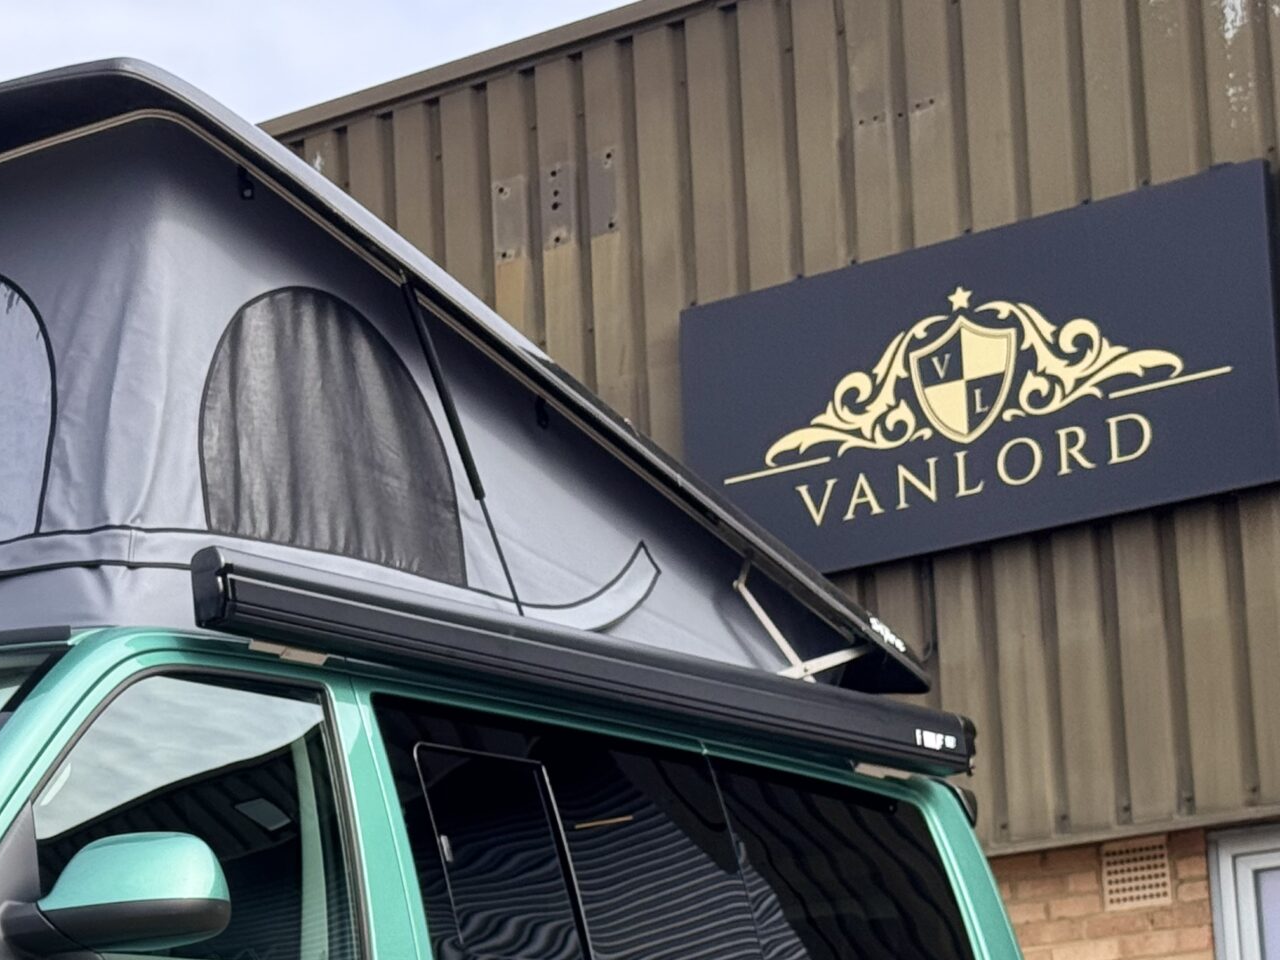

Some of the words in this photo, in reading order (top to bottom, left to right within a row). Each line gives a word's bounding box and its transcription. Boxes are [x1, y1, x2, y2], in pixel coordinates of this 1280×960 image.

[931, 353, 951, 379] V
[974, 388, 990, 414] L
[795, 412, 1152, 527] VANLORD
